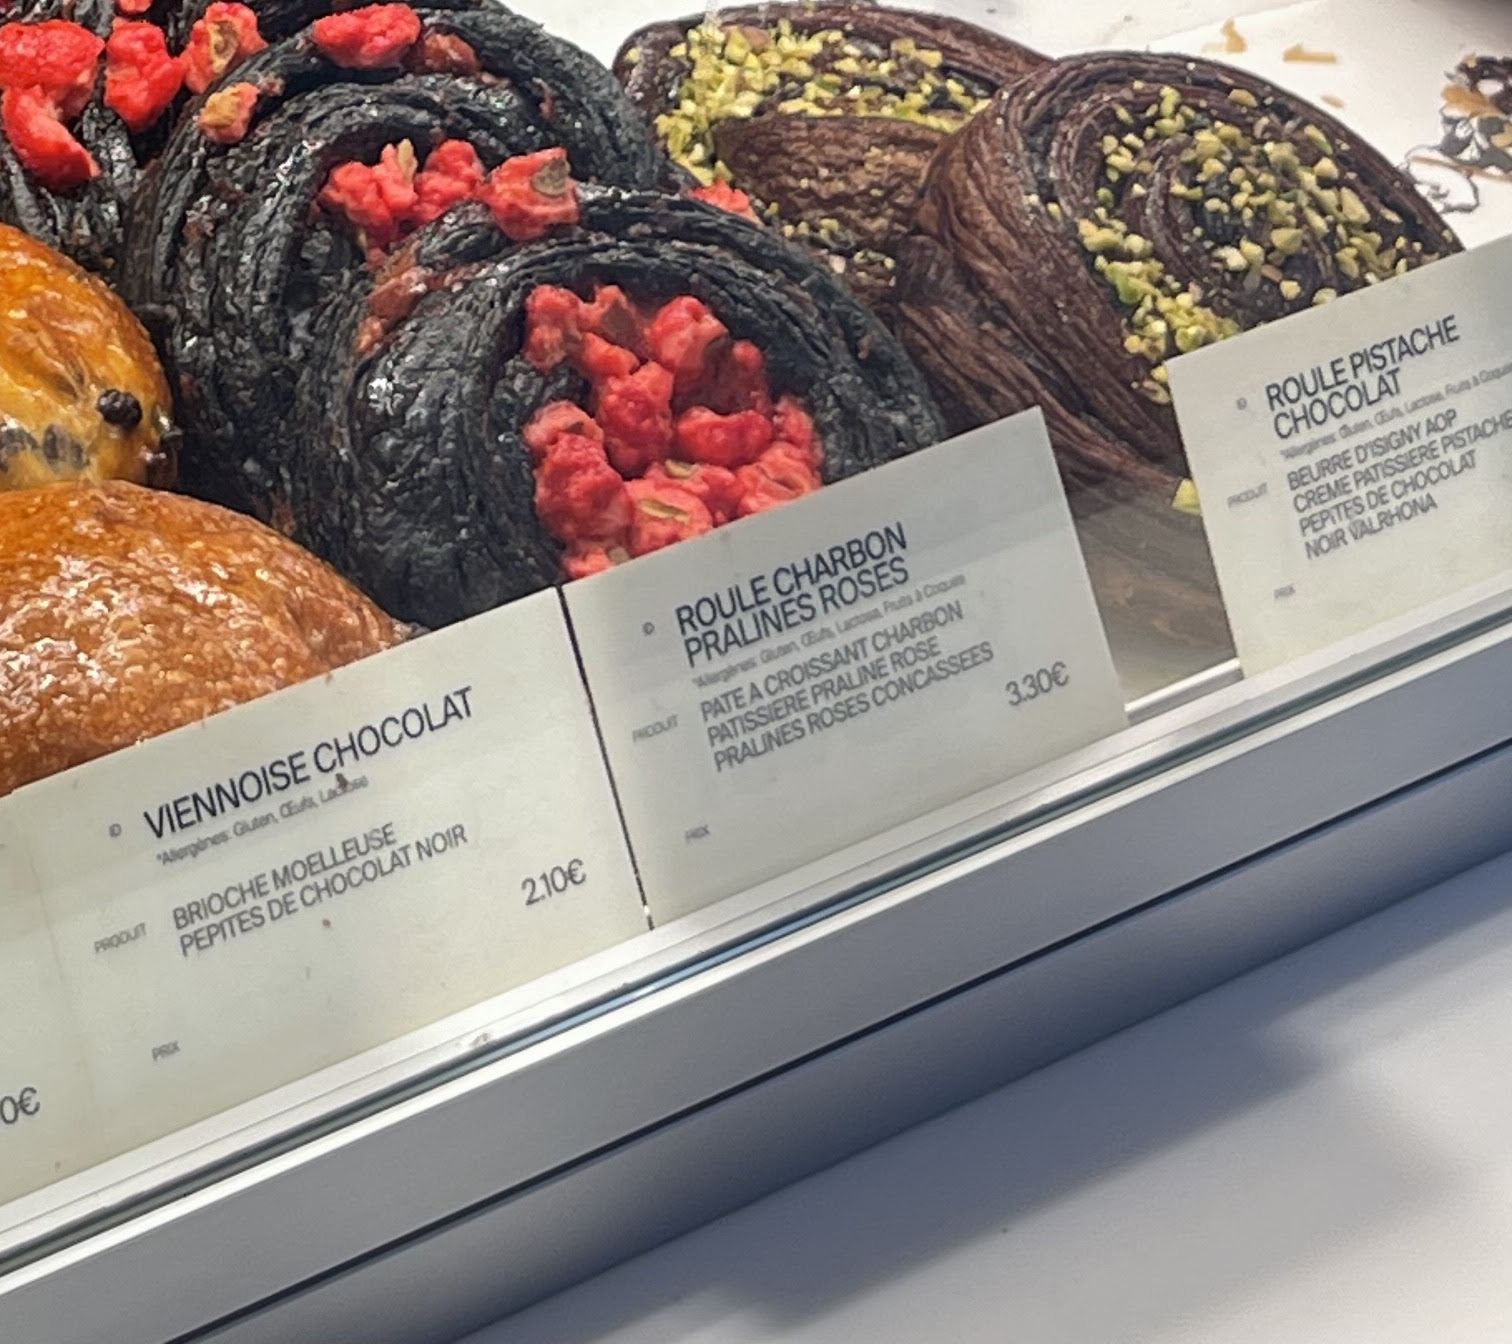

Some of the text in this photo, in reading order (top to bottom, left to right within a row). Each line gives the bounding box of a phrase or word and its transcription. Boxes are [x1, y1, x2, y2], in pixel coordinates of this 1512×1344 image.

[1265, 314, 1460, 411] ROULE PISTACHE
[1274, 368, 1401, 440] CHOCOLAT
[1287, 408, 1457, 491] BEURRE D'ISIGNY AOP
[1293, 408, 1512, 513] CREME PATISSIERE PISTACHE
[1299, 449, 1477, 537] PEPITES DE CHOCOLAT
[1305, 492, 1438, 559] NOIR VALRHONA
[675, 521, 907, 636] ROULE CHARBON
[683, 556, 909, 669] PRALINES ROSES
[700, 600, 964, 723] PATE A CROISSANT CHARBON
[708, 636, 940, 747] PATISSIERE PRALINE ROSE
[714, 640, 994, 772] PRALINES ROSES CONCASSEES
[1005, 661, 1070, 707] 3.30€
[143, 685, 473, 839] VIENNOISE CHOCOLAT
[172, 822, 397, 931] BRIOCHE MOELLEUSE
[179, 824, 468, 957] PEPITES DE CHOCOLAT NOIR
[521, 858, 587, 908] 2.10€
[93, 922, 147, 954] PRODUIT
[151, 1040, 181, 1061] PRIX
